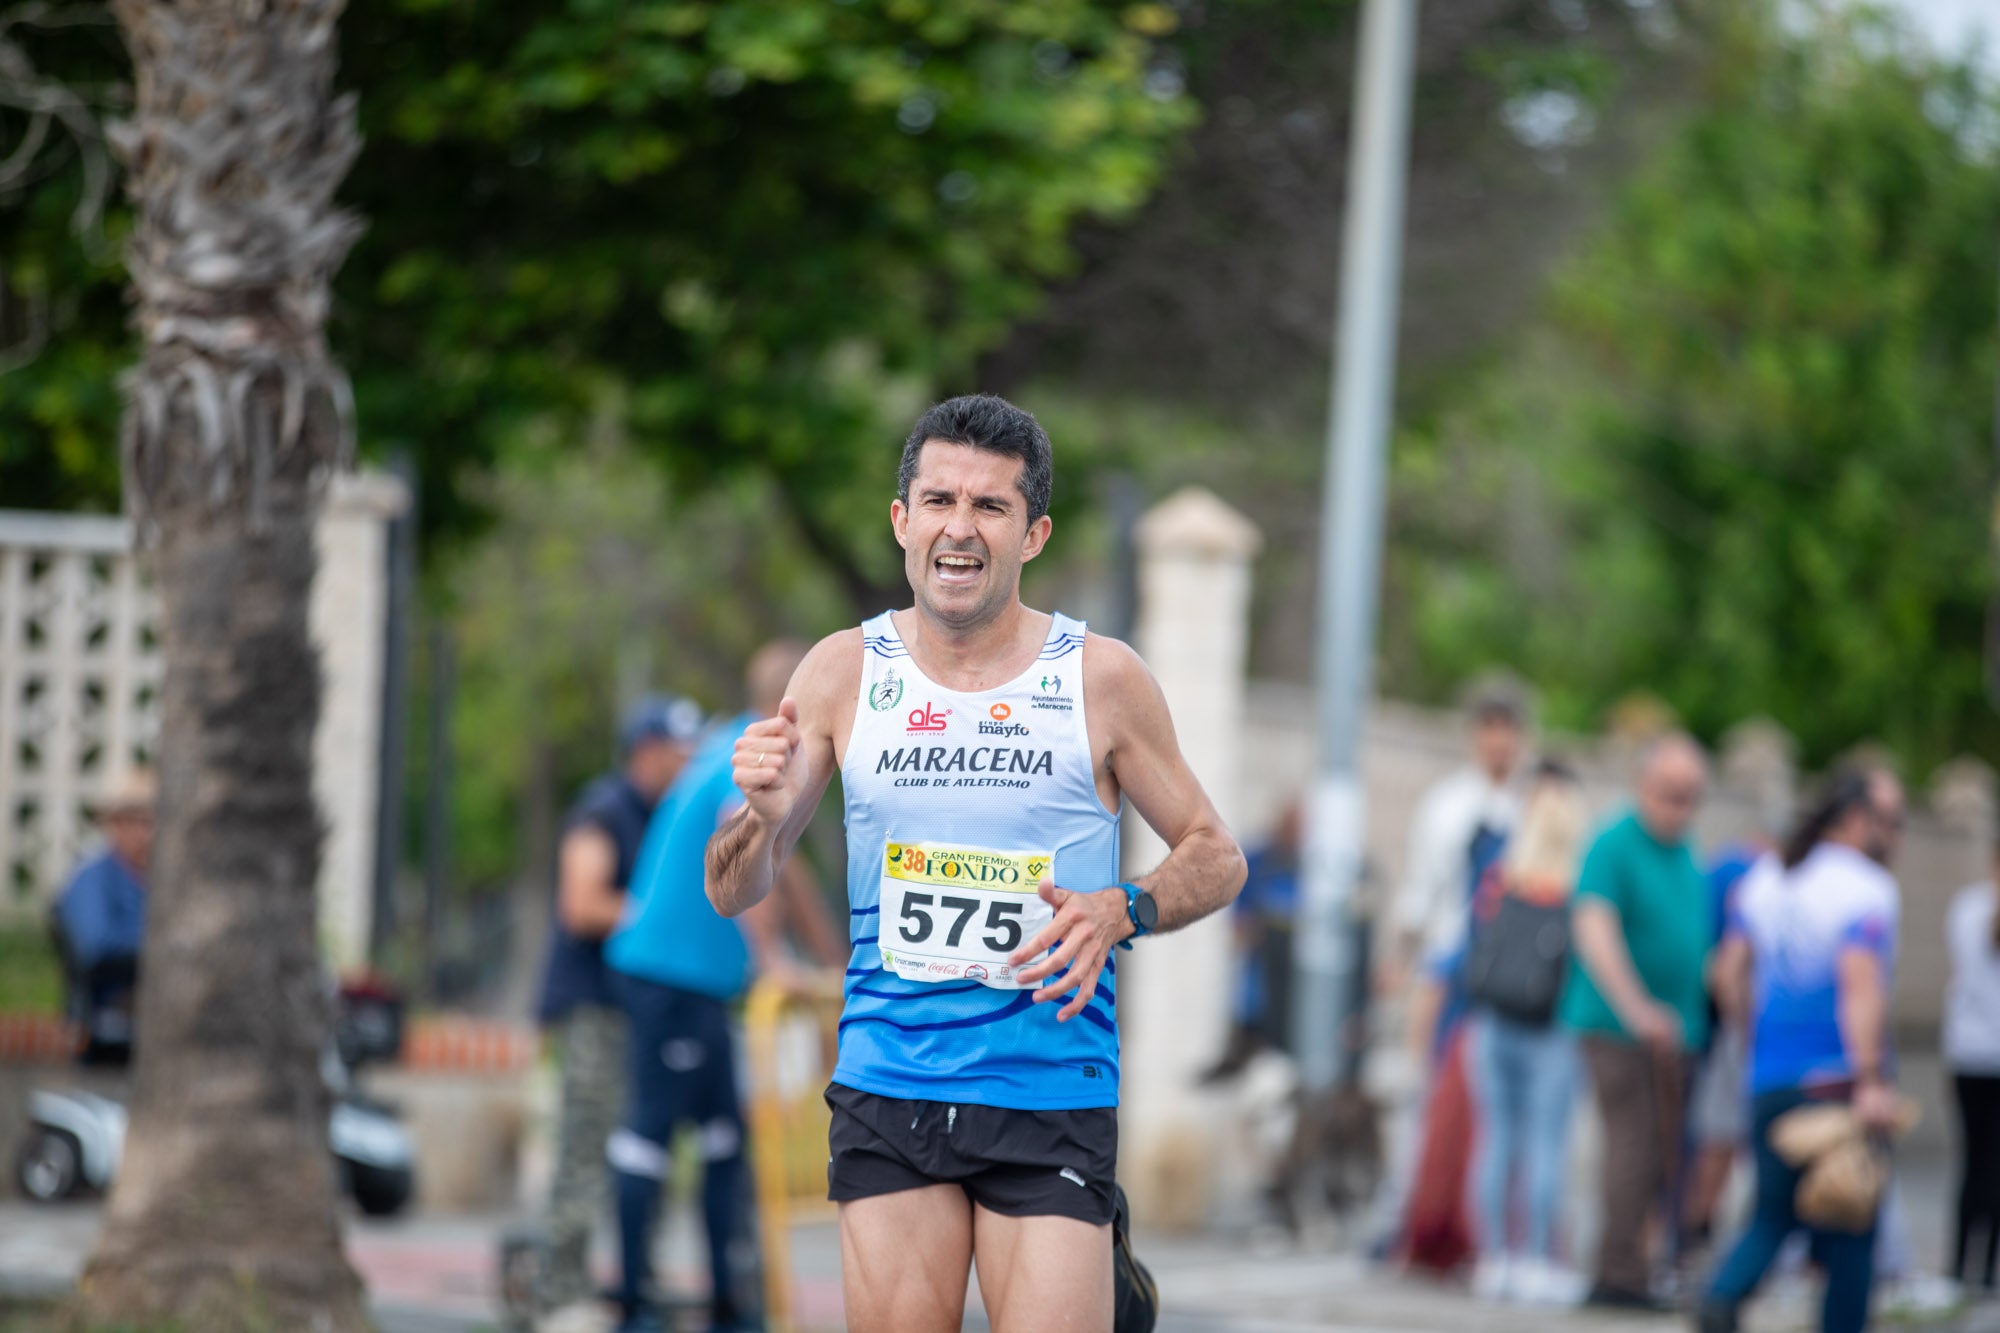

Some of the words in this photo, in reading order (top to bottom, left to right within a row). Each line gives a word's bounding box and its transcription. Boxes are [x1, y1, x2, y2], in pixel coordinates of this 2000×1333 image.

[1031, 695, 1073, 703] Ayuntamiento
[1038, 703, 1072, 711] Maracena
[978, 723, 1030, 738] mayfo
[875, 747, 1053, 776] MARACENA
[894, 778, 928, 787] CLUB
[933, 778, 949, 787] DE
[953, 778, 1030, 789] ATLETISMO
[903, 848, 926, 873] 38
[932, 851, 965, 861] GRAN
[968, 854, 1012, 867] PREMIO
[925, 859, 1019, 884] FONDO
[898, 891, 1023, 953] 575
[894, 956, 926, 968] Cruzcampo
